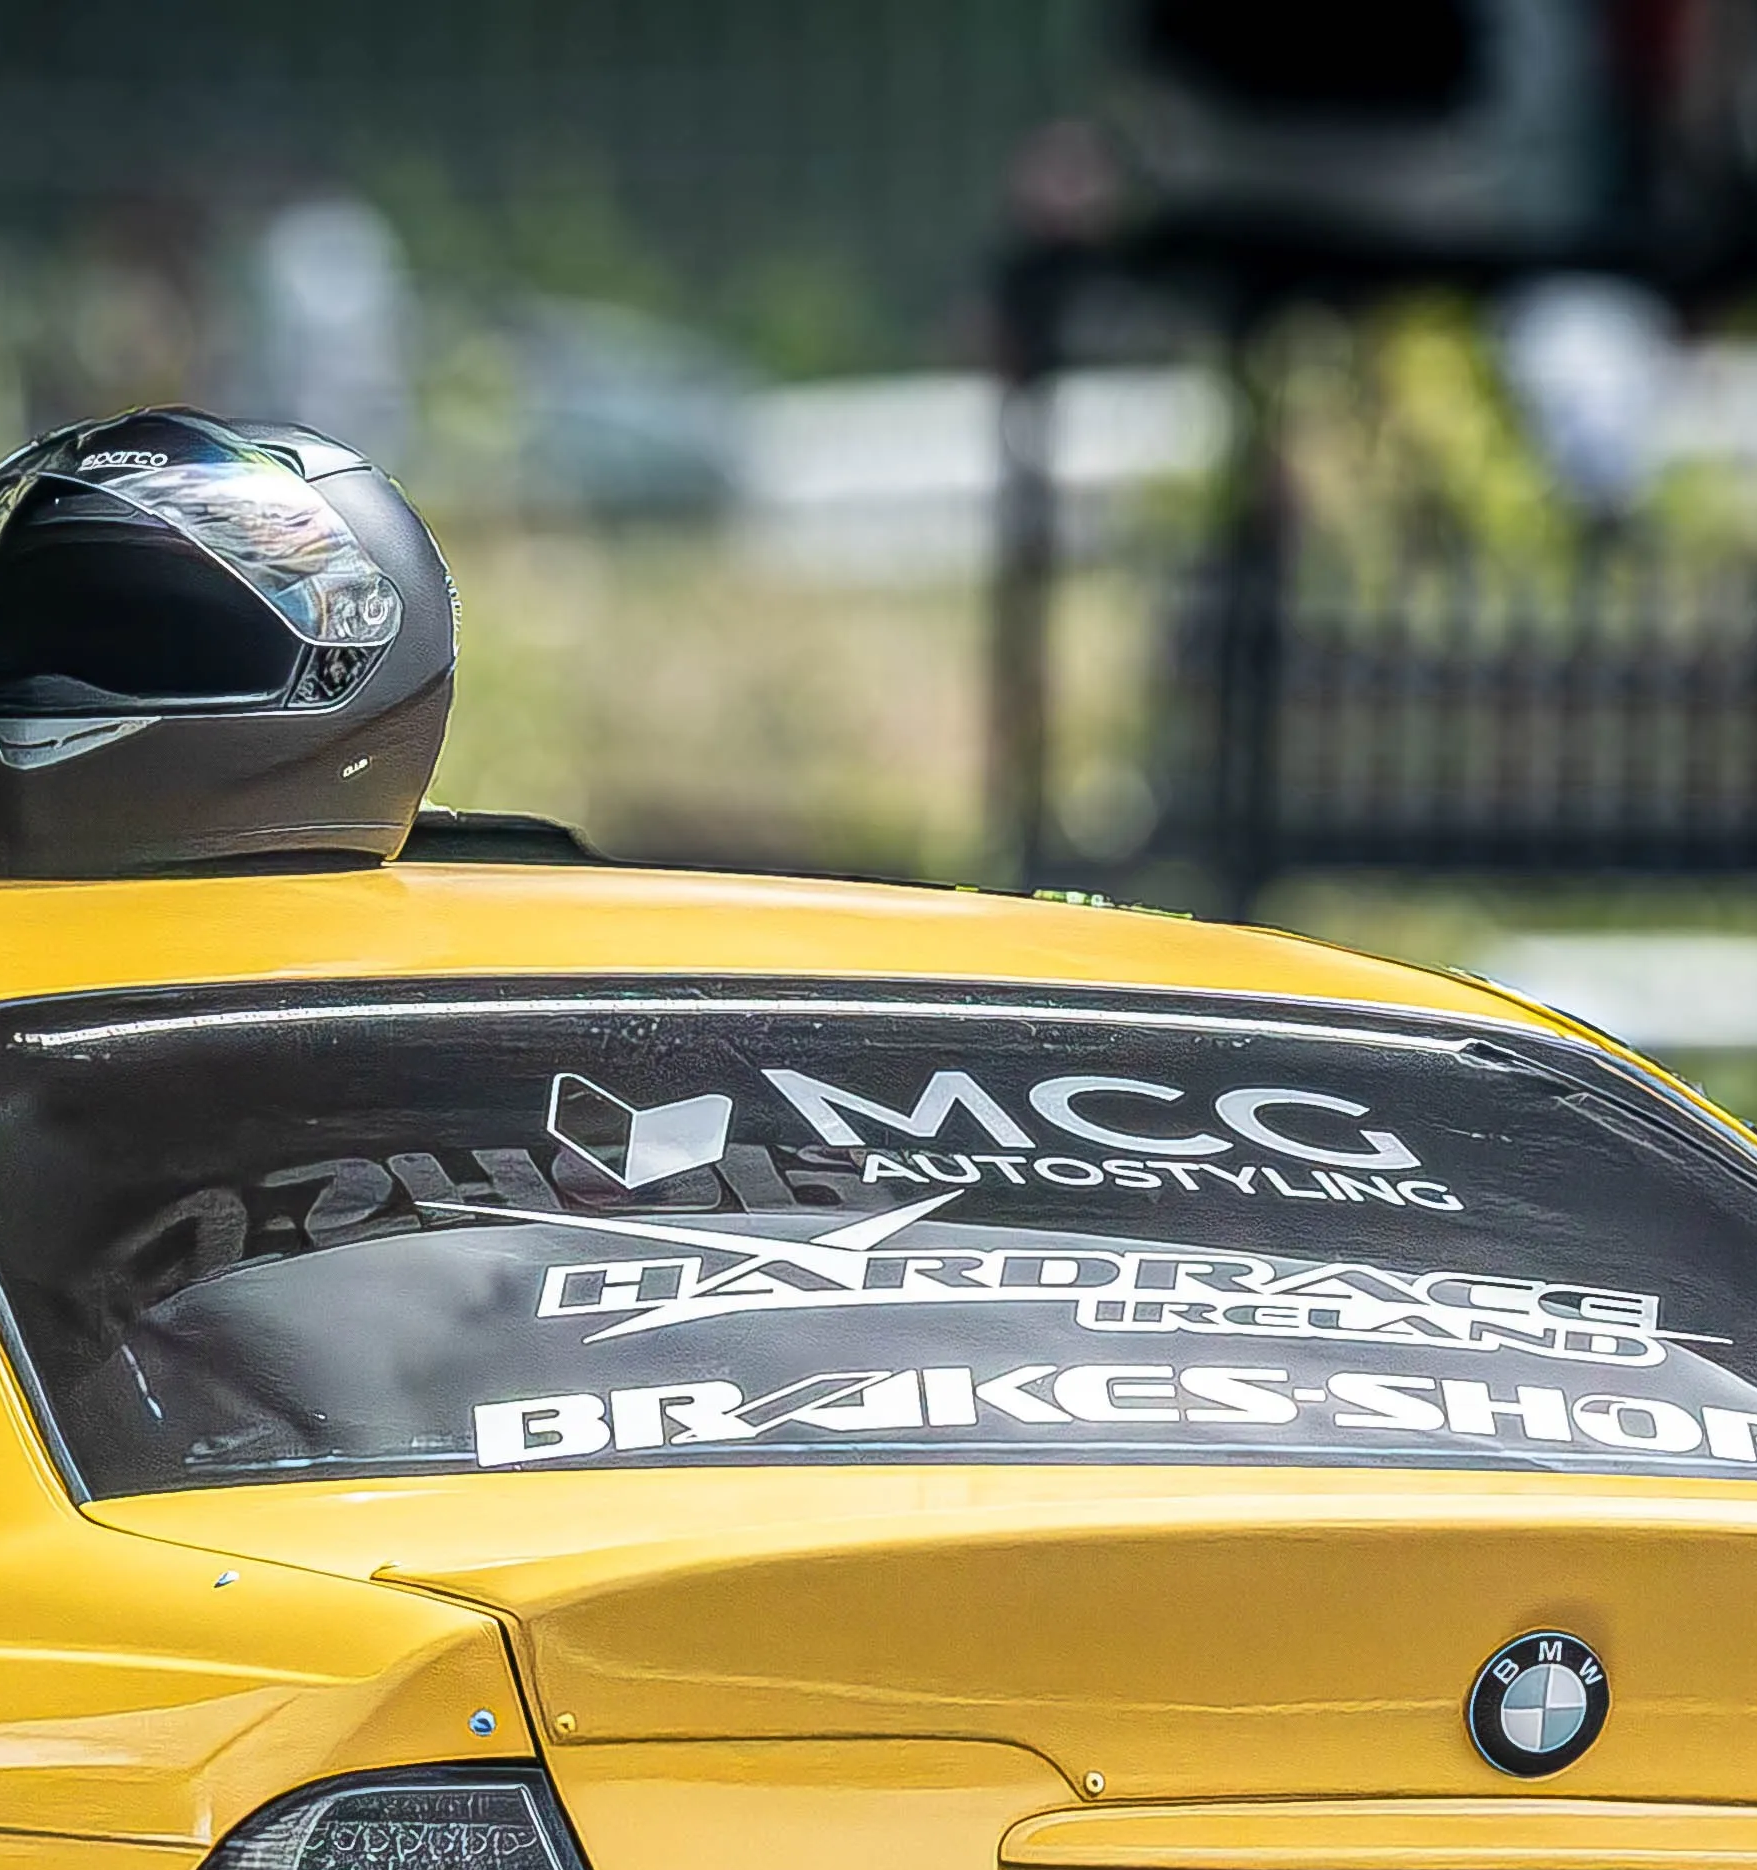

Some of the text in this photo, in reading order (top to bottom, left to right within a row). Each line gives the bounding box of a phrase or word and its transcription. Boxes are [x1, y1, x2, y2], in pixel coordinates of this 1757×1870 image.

[81, 451, 168, 468] sparco
[761, 1069, 1421, 1170] MCG
[862, 1155, 1464, 1210] AUTOSTYLING
[537, 1248, 1661, 1328] HARDRACE
[1079, 1298, 1668, 1367] IRELAND
[1492, 1641, 1604, 1685] BMW
